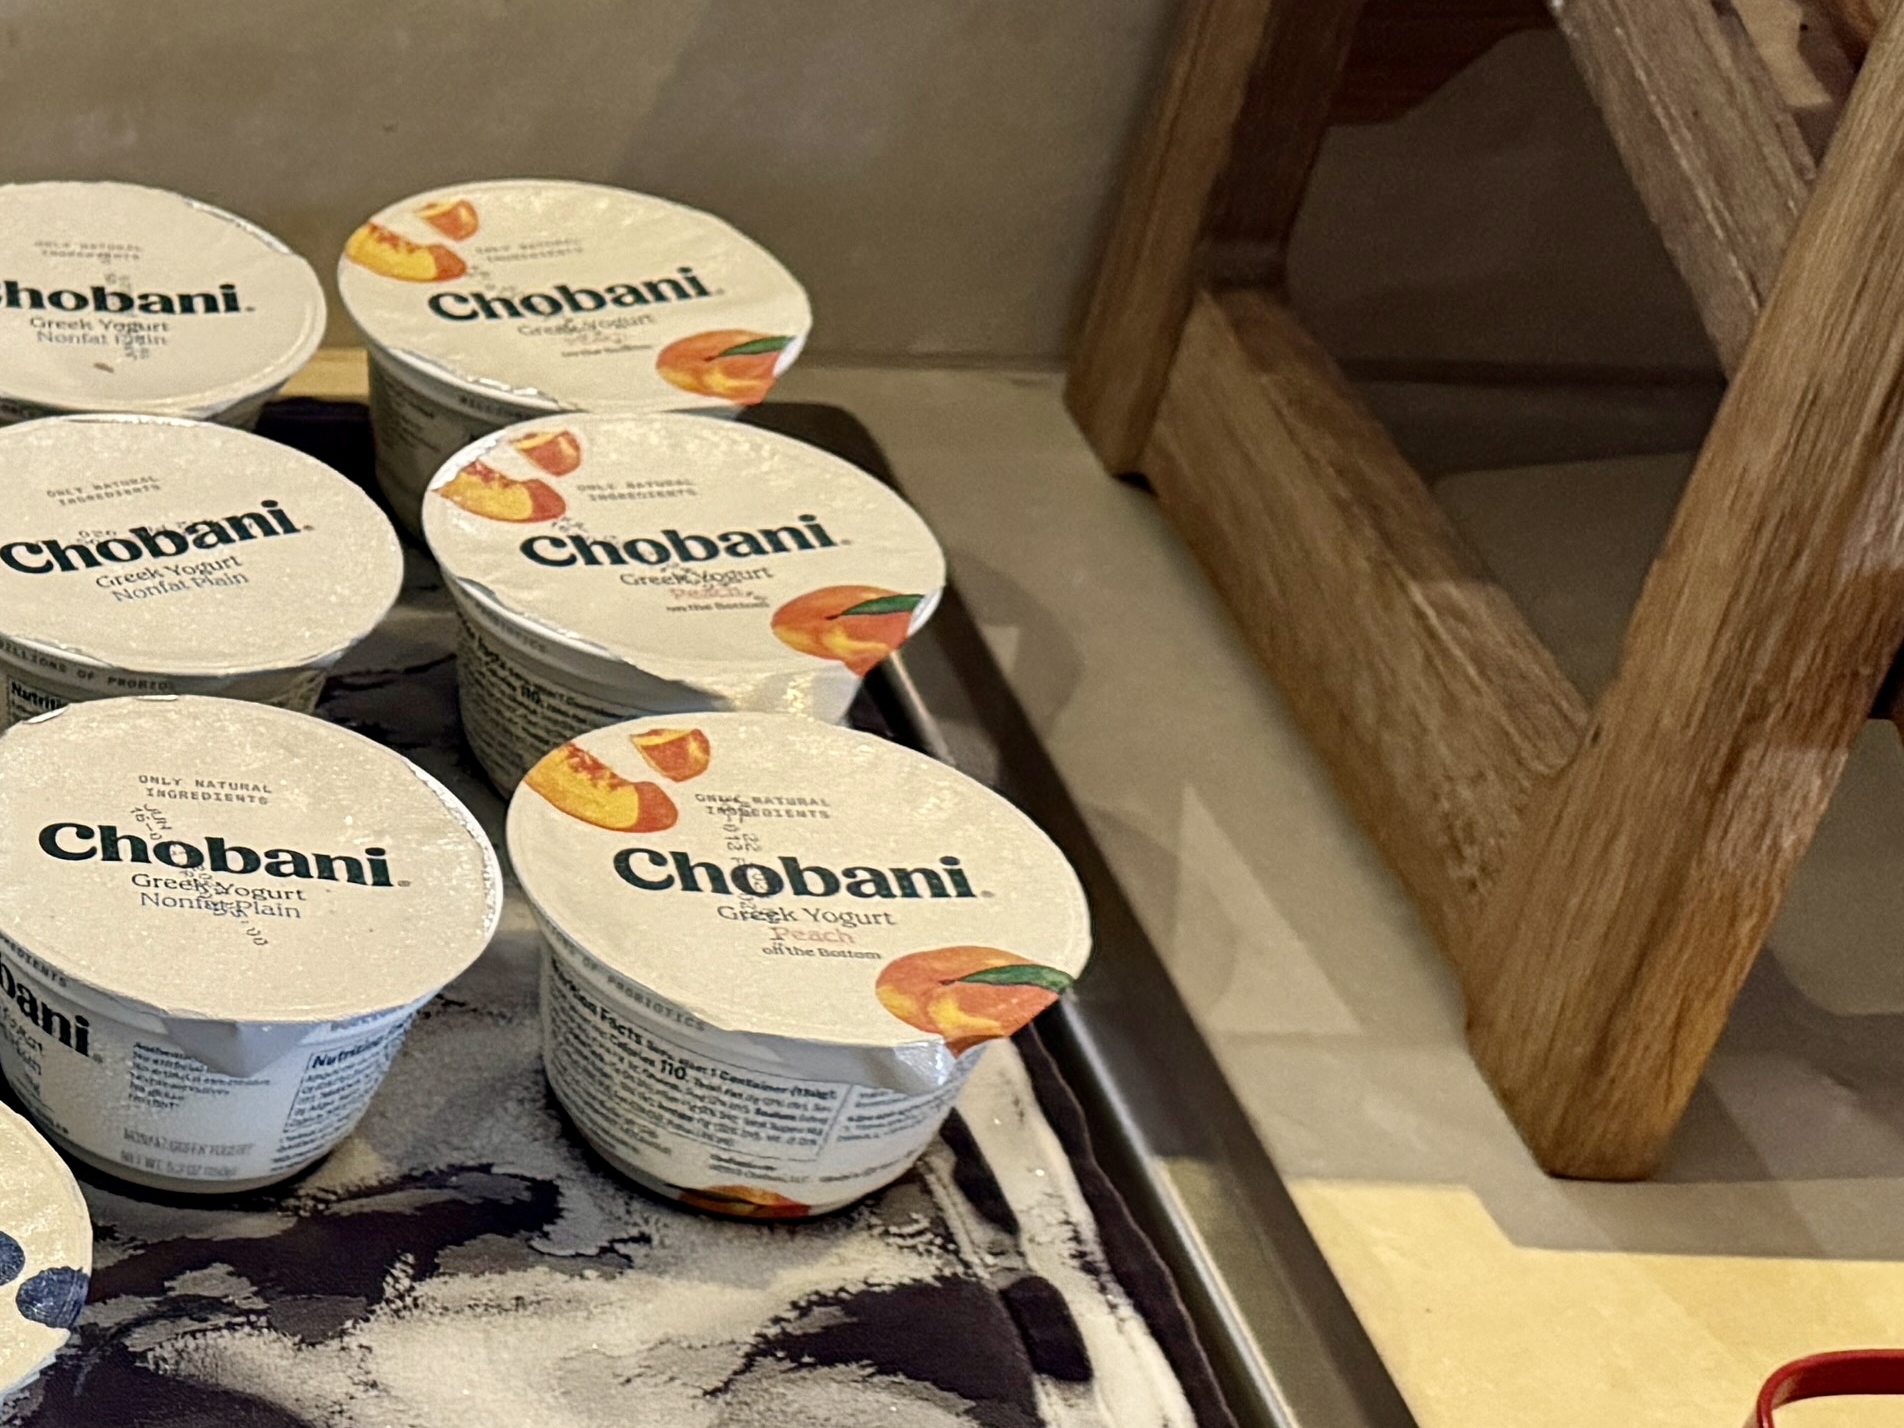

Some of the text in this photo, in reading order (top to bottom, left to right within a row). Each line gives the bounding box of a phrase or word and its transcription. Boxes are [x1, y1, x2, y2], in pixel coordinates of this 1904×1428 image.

[428, 267, 711, 322] Chobani
[29, 317, 169, 336] Greek Yogurt
[0, 500, 301, 575] Chobani
[520, 514, 839, 568] Chobani
[96, 555, 243, 589] Greek Yogurt
[112, 572, 249, 602] Nonfat Plain
[138, 774, 272, 794] ONLY NATURAL
[145, 787, 269, 806] INGREDIENTS
[38, 822, 394, 888] Chobani
[131, 873, 307, 902] Greek Yogurt
[613, 848, 976, 899] Chobani
[235, 899, 301, 919] Plain
[717, 904, 897, 929] Greek Yogurt
[769, 926, 855, 945] Peach
[599, 1005, 642, 1045] Facts
